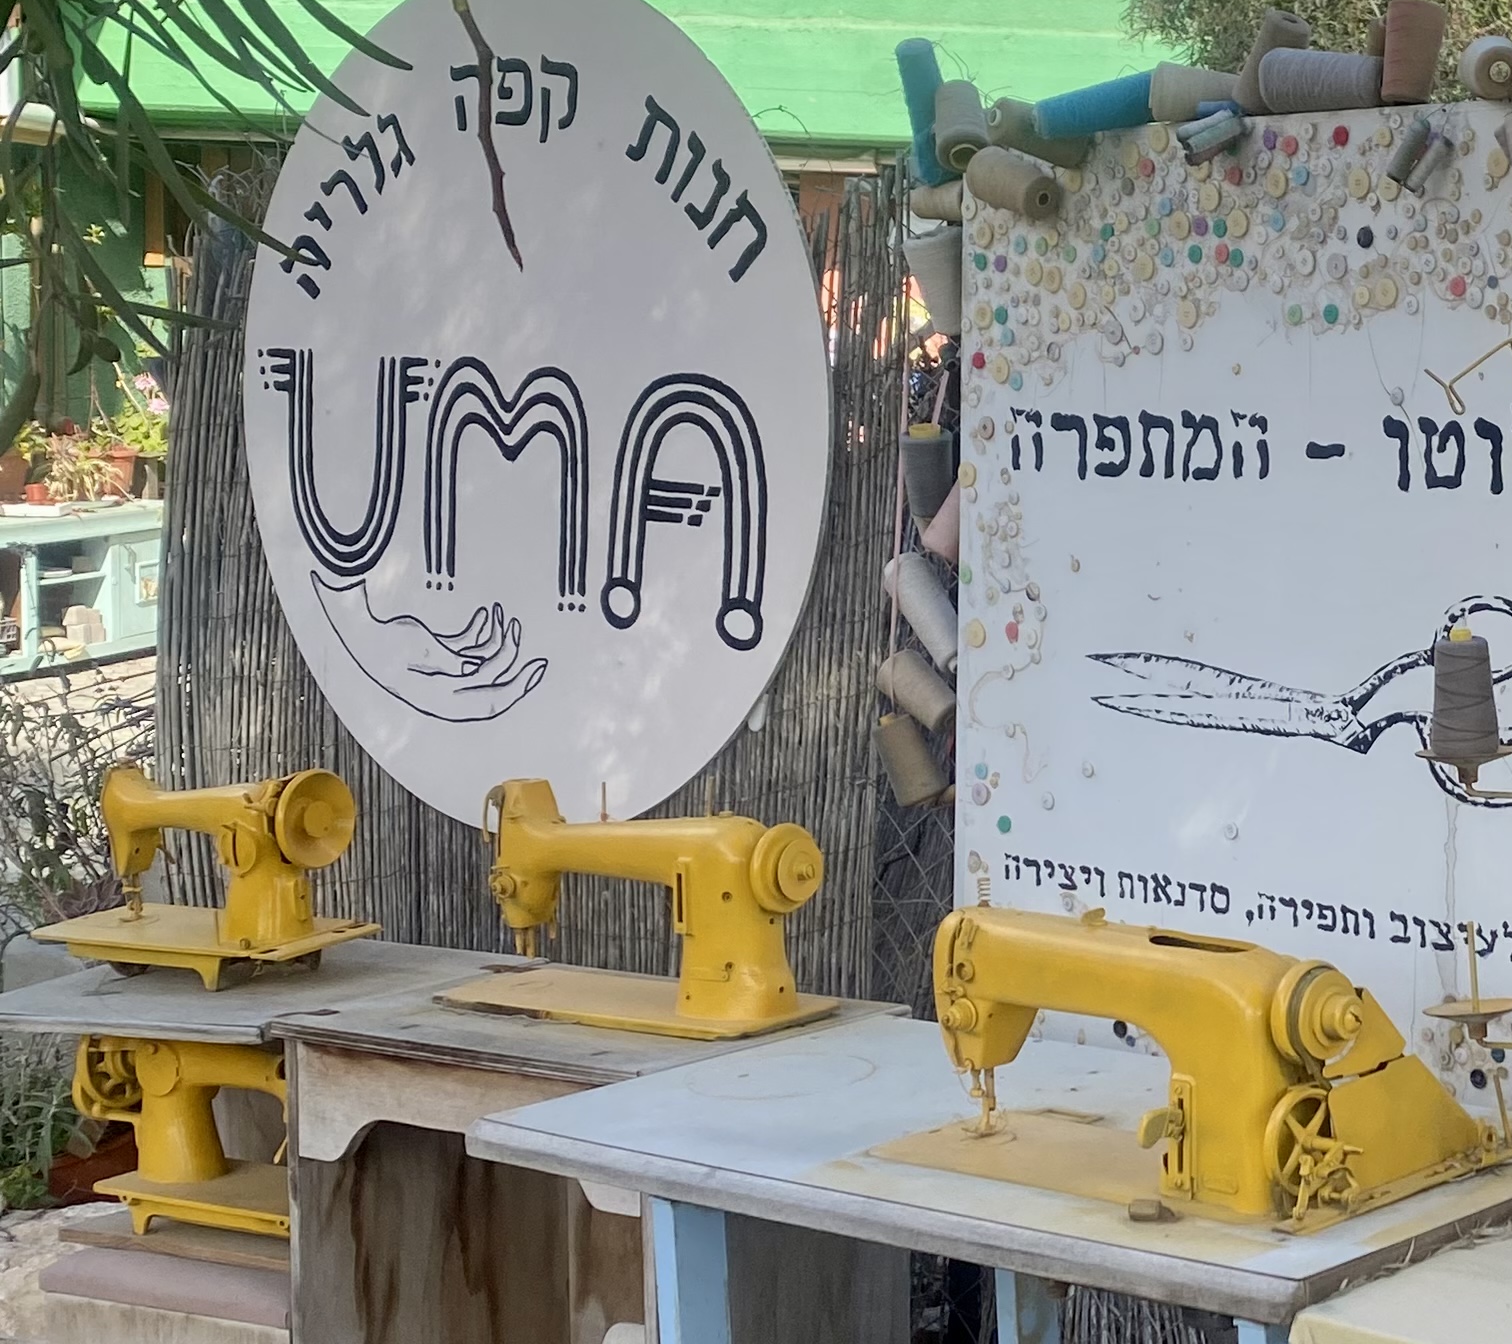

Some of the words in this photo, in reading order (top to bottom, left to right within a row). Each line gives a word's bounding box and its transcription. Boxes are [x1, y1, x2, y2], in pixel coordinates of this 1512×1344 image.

[449, 54, 578, 143] קפה
[279, 112, 414, 299] גלריה
[626, 94, 767, 283] חנות
[257, 347, 767, 652] UMA
[1010, 407, 1270, 482] המתפרה
[1003, 853, 1106, 899] ויצירה
